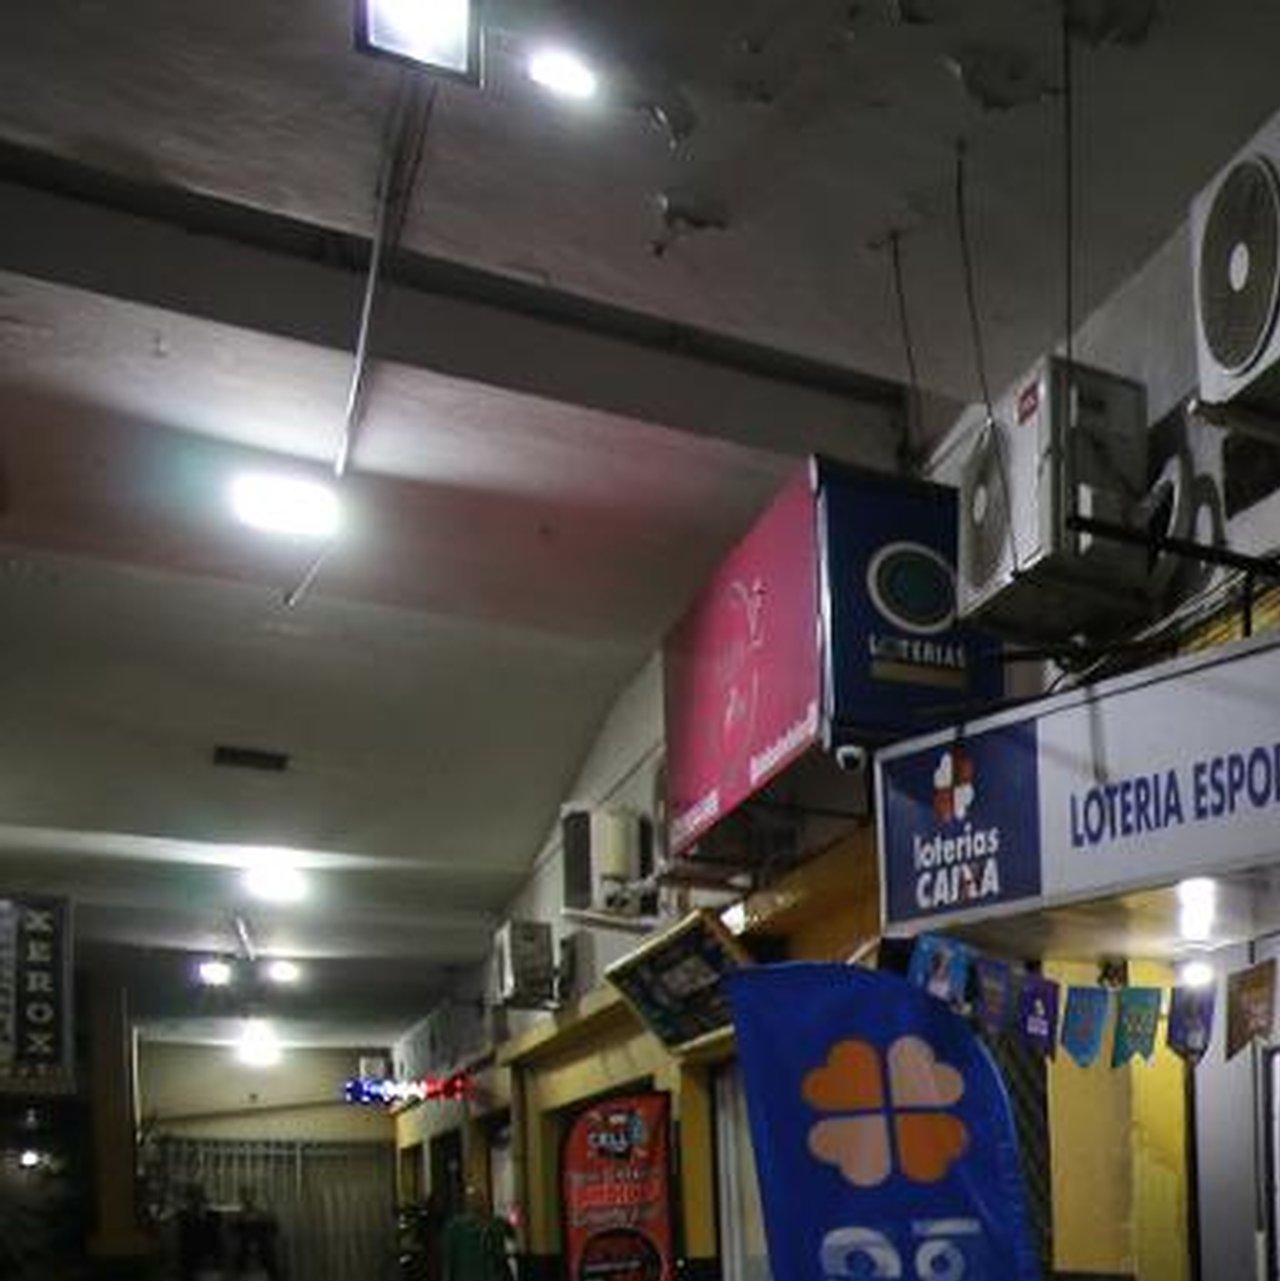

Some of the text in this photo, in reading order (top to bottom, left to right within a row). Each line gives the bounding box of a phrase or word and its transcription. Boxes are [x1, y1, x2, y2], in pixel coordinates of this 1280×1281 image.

[1070, 769, 1184, 848] LOTERIA
[913, 822, 1000, 871] loterias
[916, 857, 1000, 909] CAIXA
[25, 909, 55, 1055] XEROX
